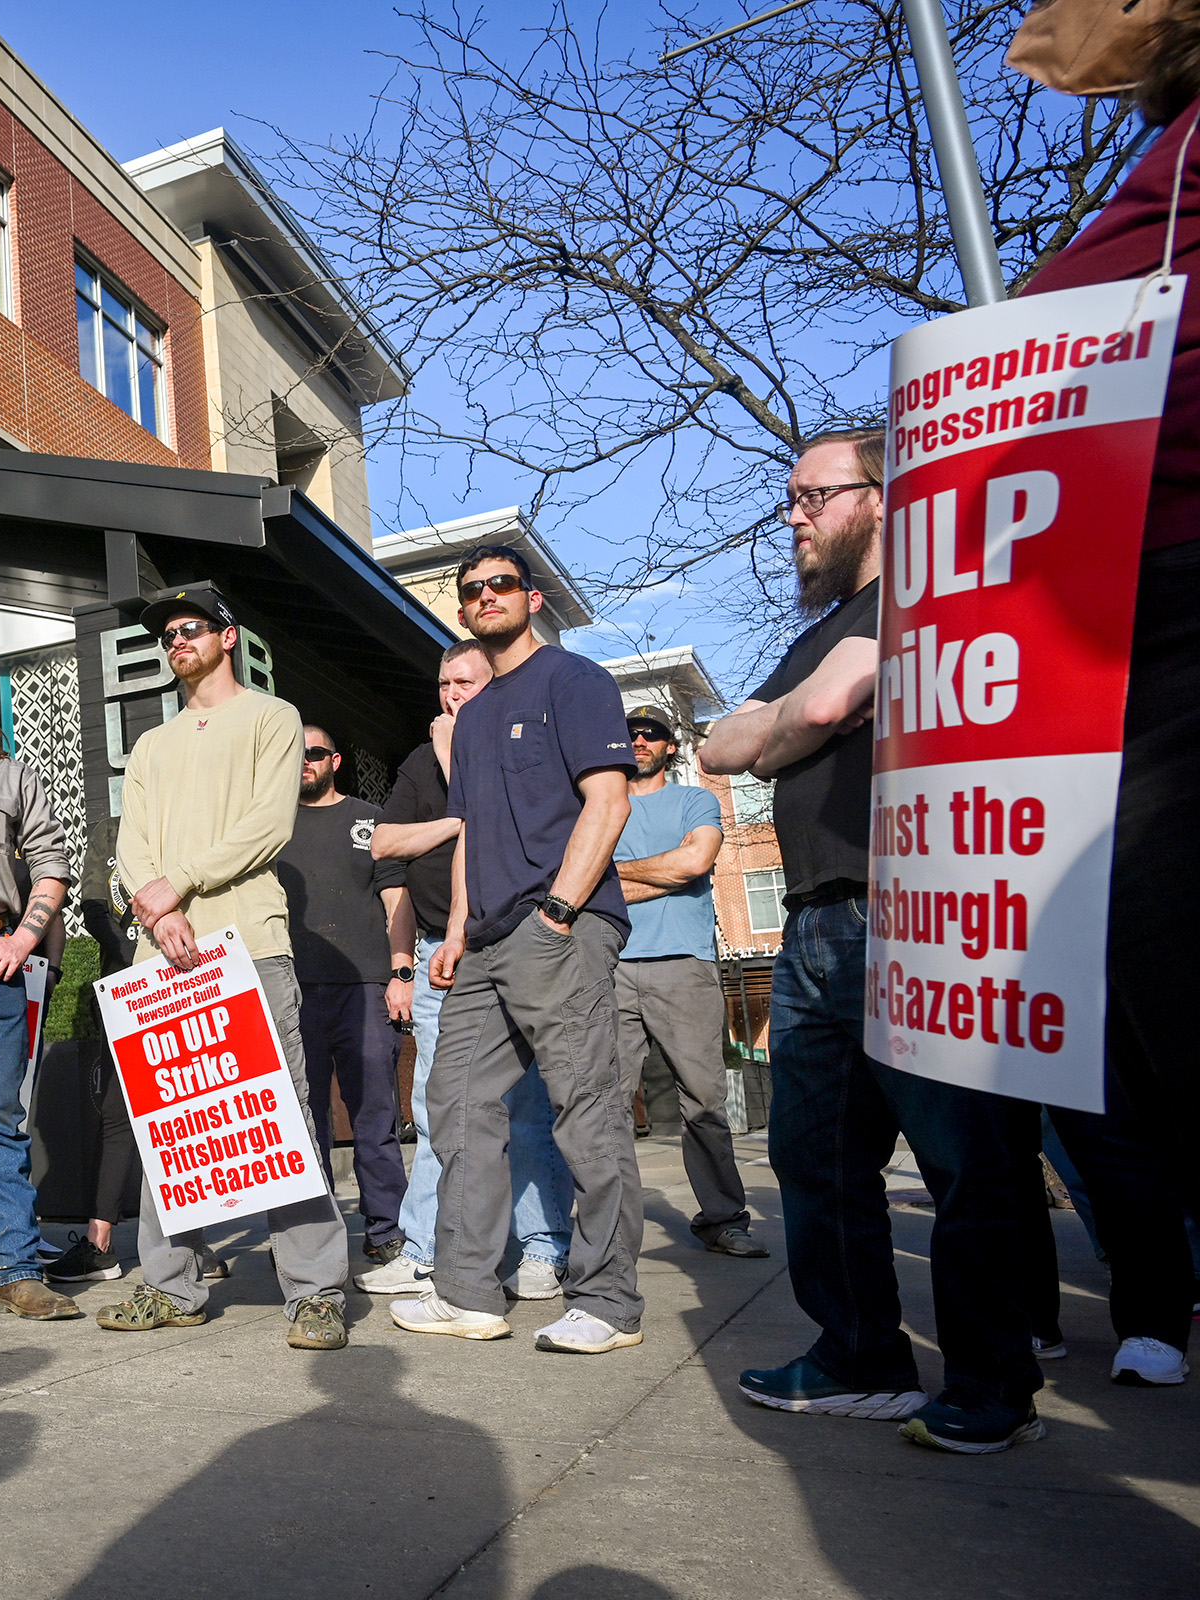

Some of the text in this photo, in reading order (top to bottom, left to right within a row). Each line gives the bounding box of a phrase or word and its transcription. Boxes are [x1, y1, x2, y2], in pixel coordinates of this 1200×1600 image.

[895, 384, 1089, 467] Pressman
[893, 470, 1061, 609] ULP
[876, 624, 1020, 741] rike
[949, 786, 1045, 856] the
[111, 944, 227, 1000] Mailers Typohical
[126, 967, 224, 1012] Teamster Pressman
[136, 983, 222, 1026] Newspaper Guild
[142, 1006, 230, 1067] On ULP
[155, 1051, 240, 1103] Strike
[147, 1088, 277, 1149] Against the
[159, 1117, 283, 1178] Pittsburgh
[159, 1150, 306, 1211] Post-Gazette
